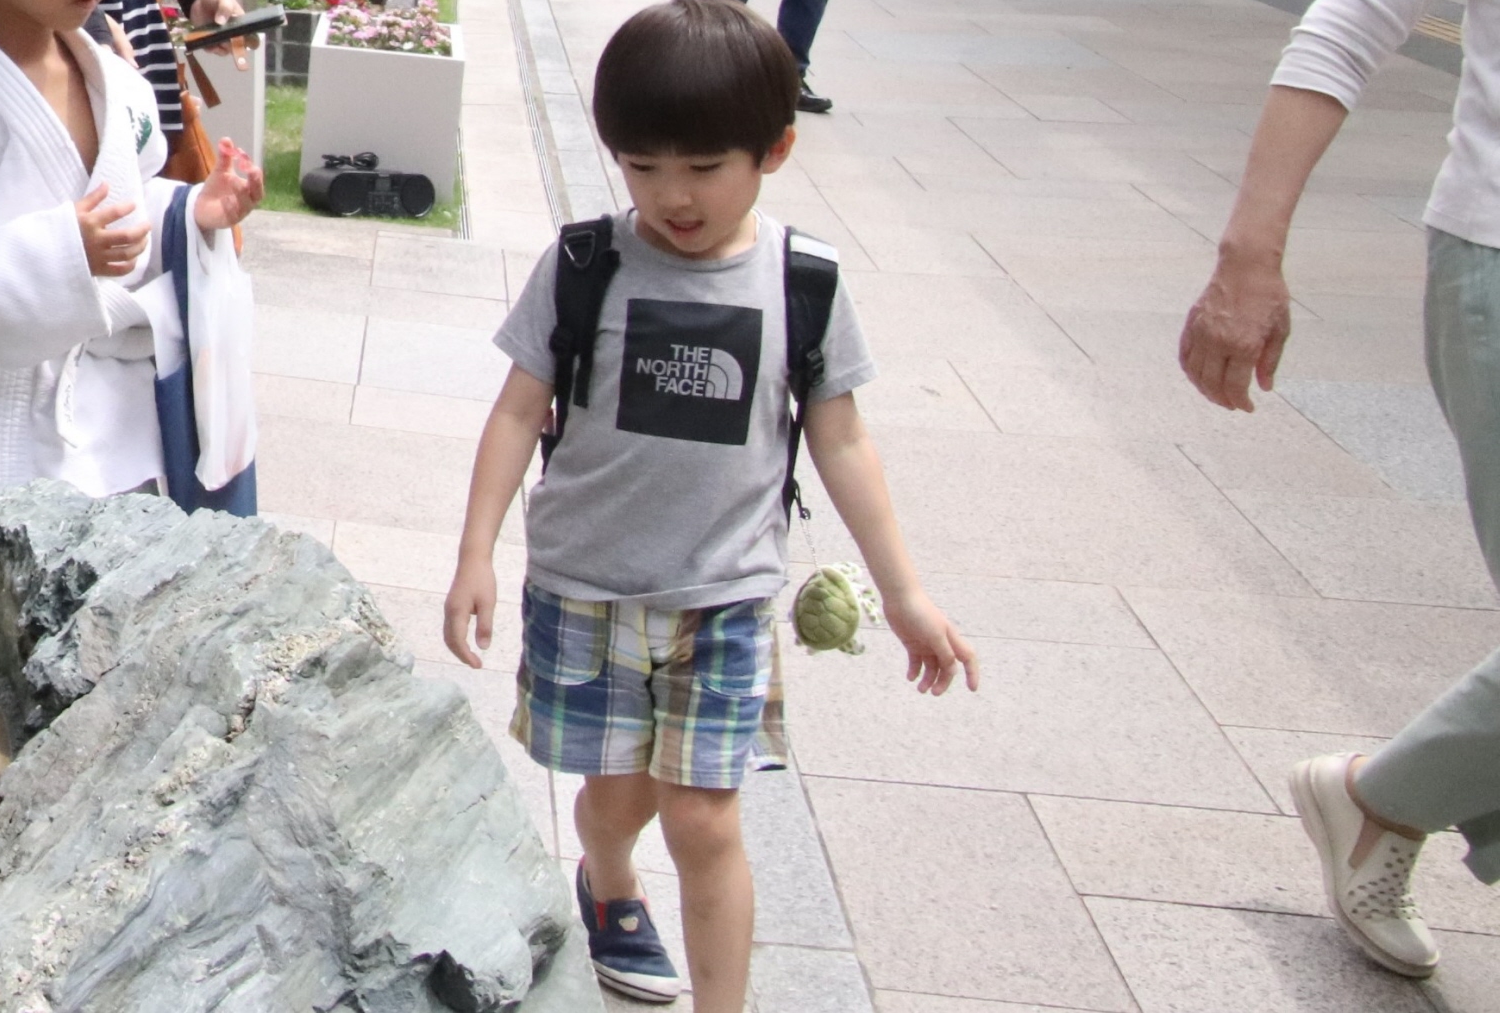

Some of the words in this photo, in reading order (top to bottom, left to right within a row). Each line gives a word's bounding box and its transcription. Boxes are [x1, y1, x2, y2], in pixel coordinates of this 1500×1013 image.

[670, 344, 710, 363] THE
[636, 358, 709, 380] NORTH
[655, 376, 705, 397] FACE
